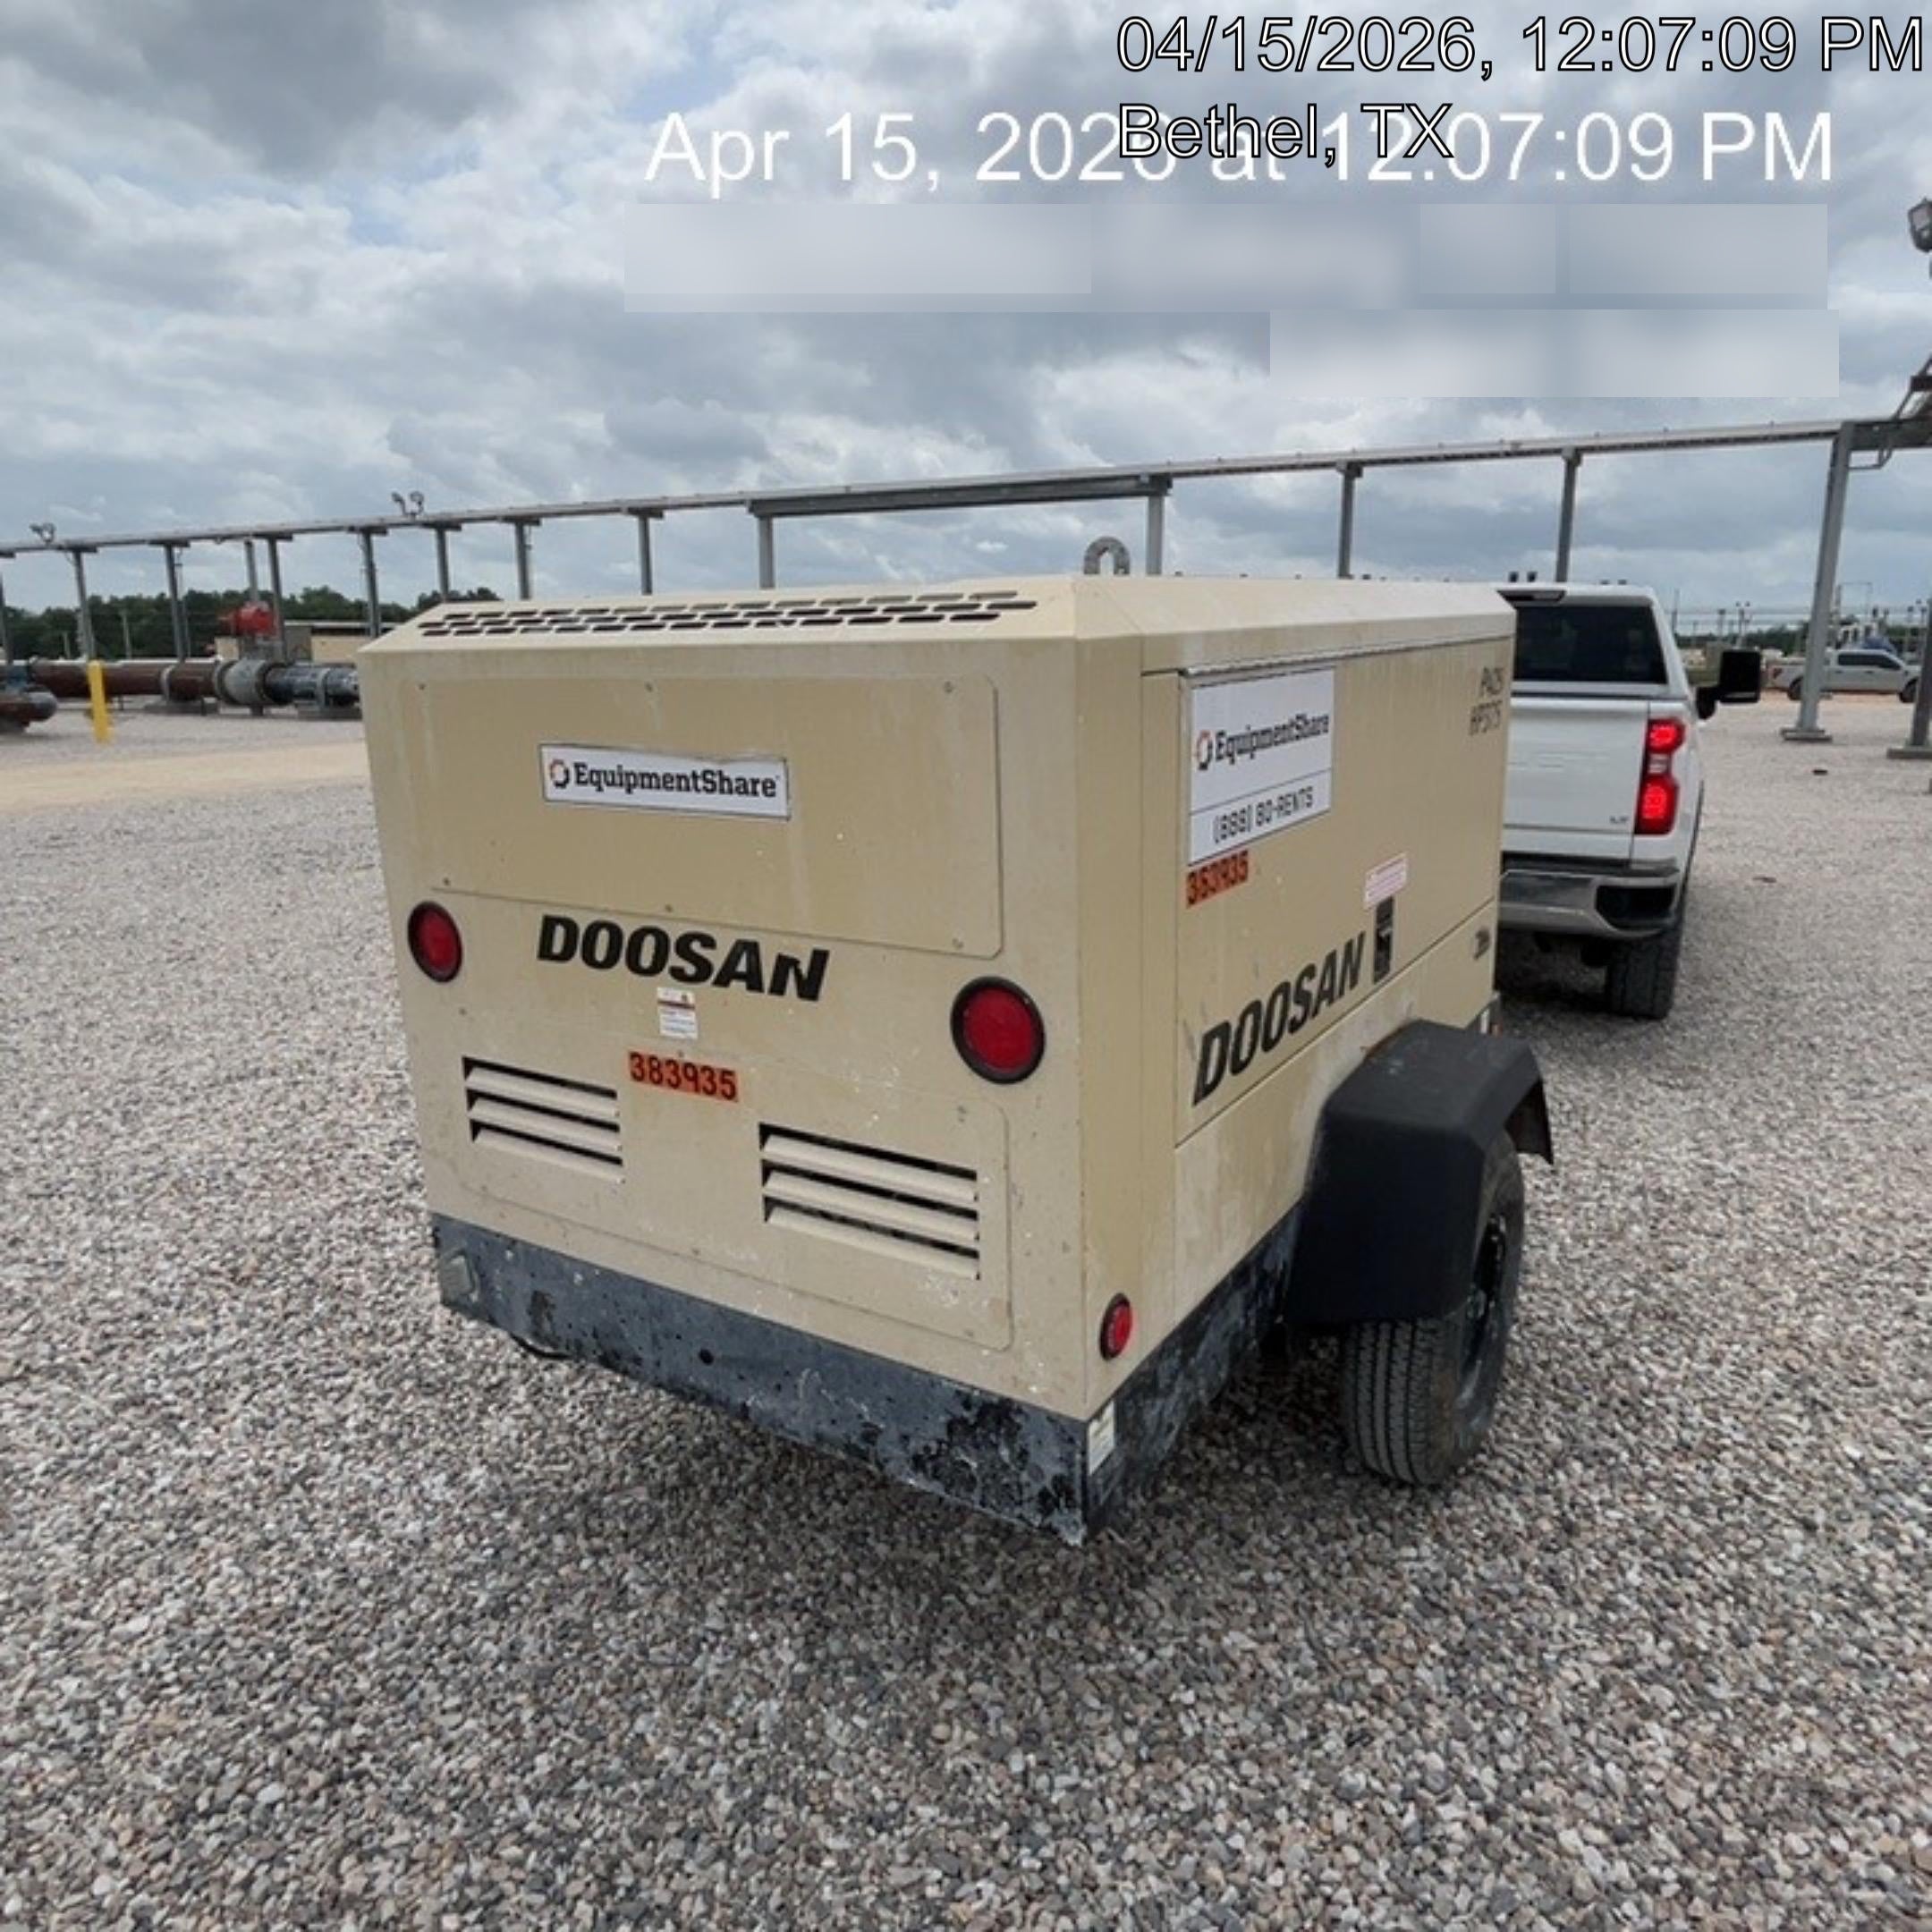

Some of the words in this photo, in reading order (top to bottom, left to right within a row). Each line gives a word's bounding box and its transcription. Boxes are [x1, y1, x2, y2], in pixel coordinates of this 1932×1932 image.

[1215, 714, 1329, 766] EquipmentShare
[573, 762, 777, 800] EquipmentShare
[537, 914, 830, 1003] DOOSAN
[1192, 931, 1367, 1106] DOOSAN
[629, 1050, 738, 1101] 383935
